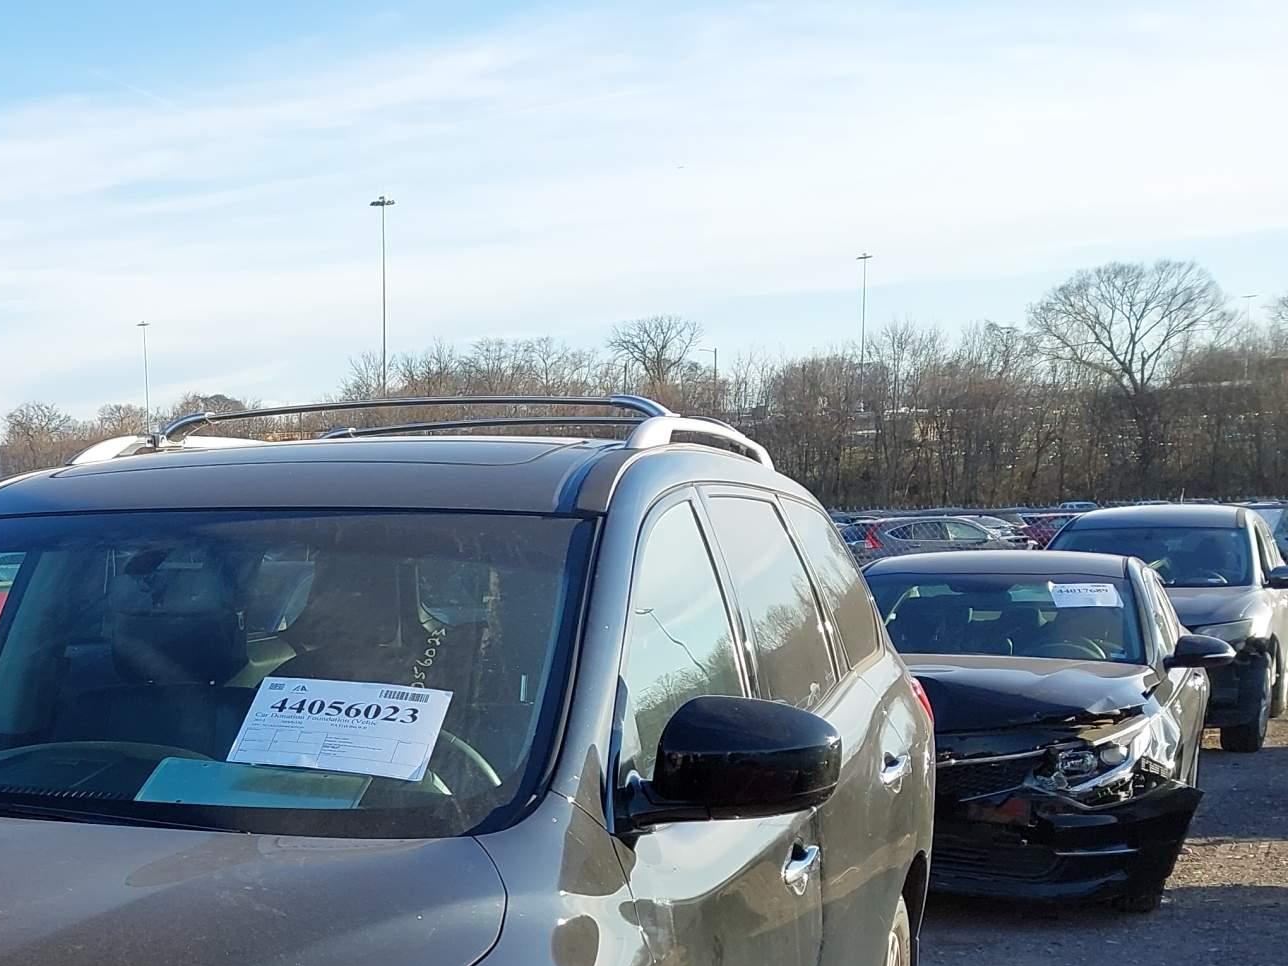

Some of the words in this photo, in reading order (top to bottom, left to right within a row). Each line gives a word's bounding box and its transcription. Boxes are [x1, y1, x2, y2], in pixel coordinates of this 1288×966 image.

[270, 697, 420, 724] 44056023
[270, 712, 305, 720] Donation
[307, 714, 350, 724] Foundation
